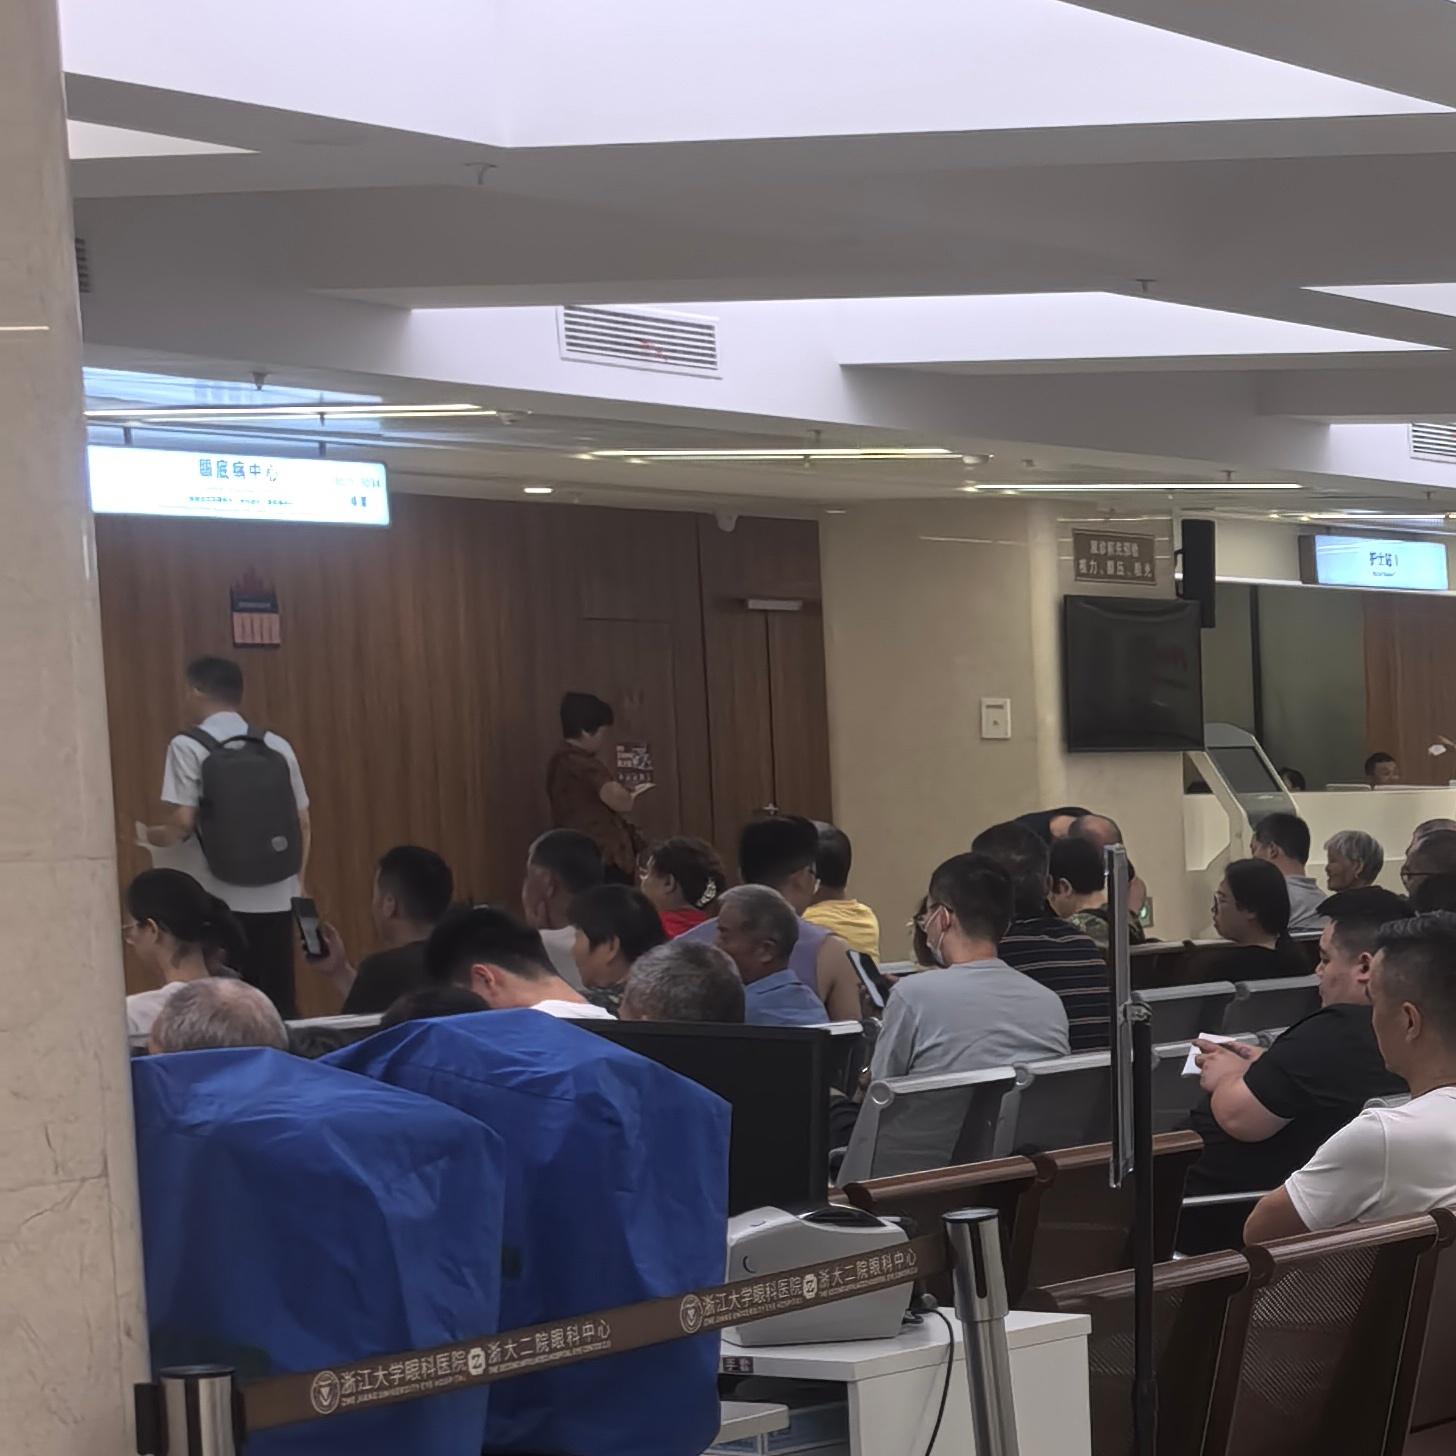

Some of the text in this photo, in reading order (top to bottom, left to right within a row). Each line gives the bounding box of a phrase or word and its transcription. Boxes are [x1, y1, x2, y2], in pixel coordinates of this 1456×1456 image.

[340, 1349, 468, 1395] 浙江大学眼科医院
[487, 1319, 611, 1365] 浙大二院眼科中心
